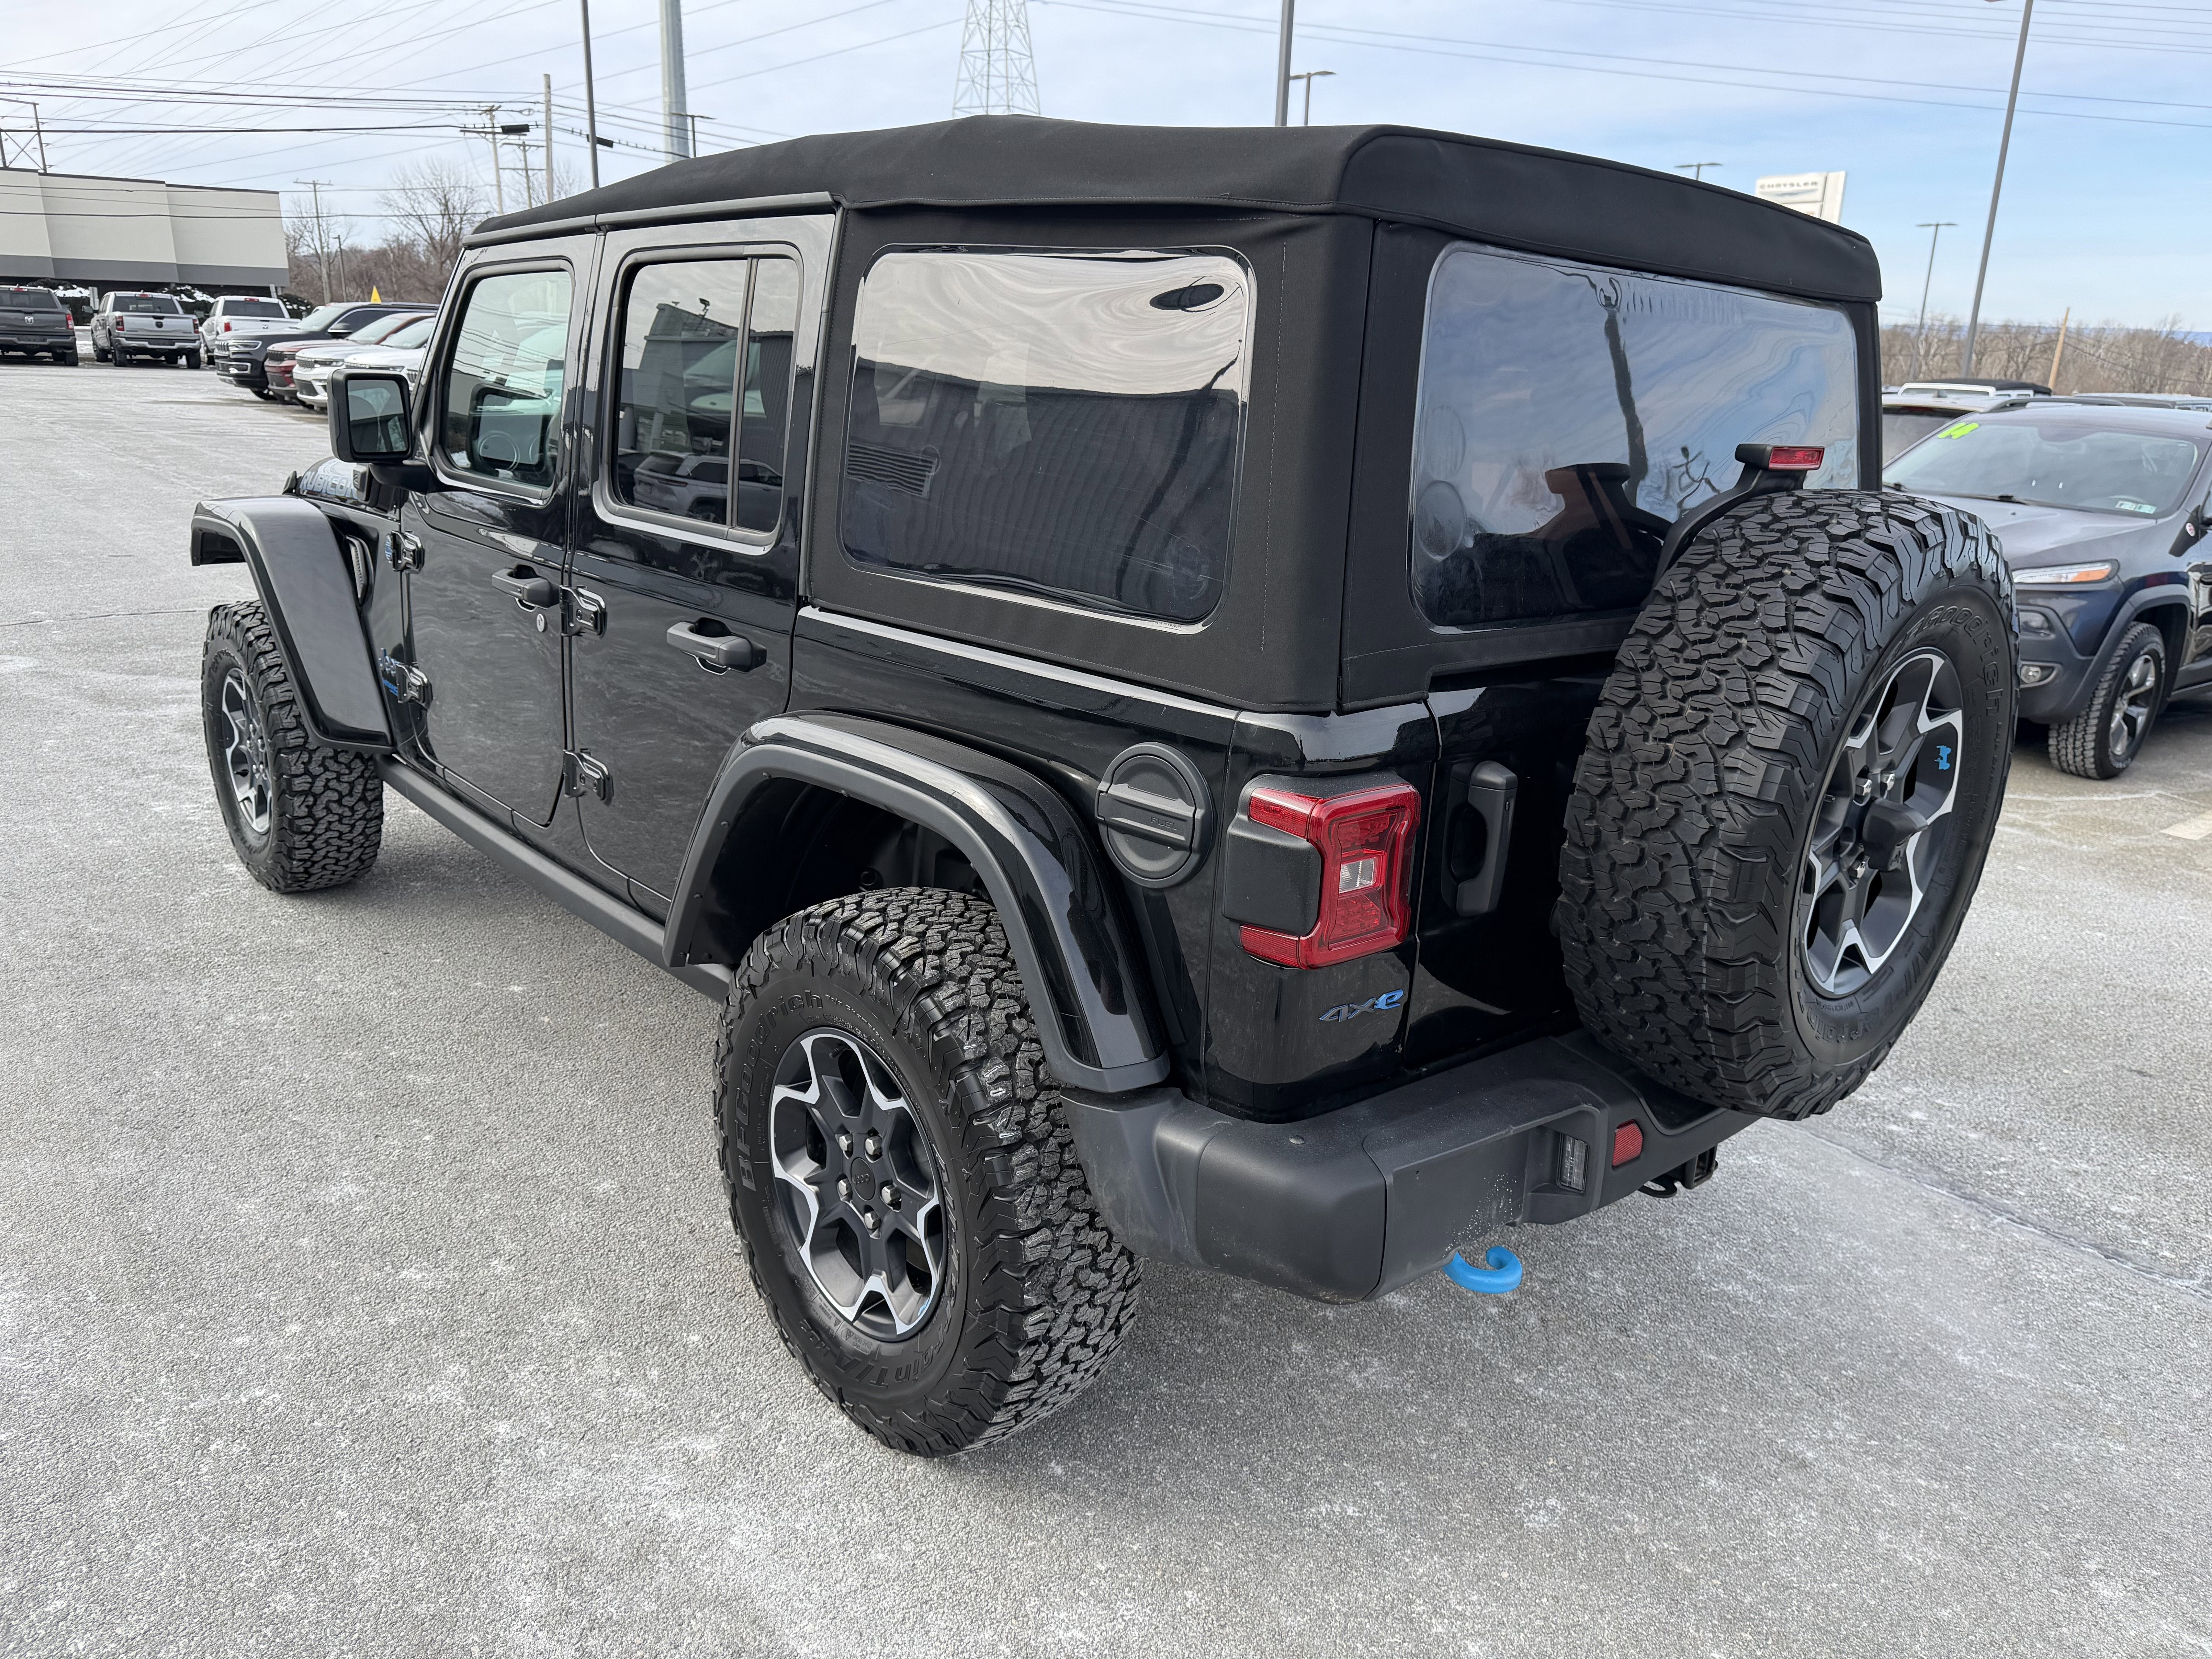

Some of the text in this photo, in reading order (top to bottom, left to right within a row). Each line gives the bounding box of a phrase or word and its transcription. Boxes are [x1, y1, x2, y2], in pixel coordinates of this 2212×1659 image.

[1759, 181, 1818, 190] CHRYSLER
[1151, 816, 1179, 831] FUEL
[735, 990, 823, 1192] BFGoodrich
